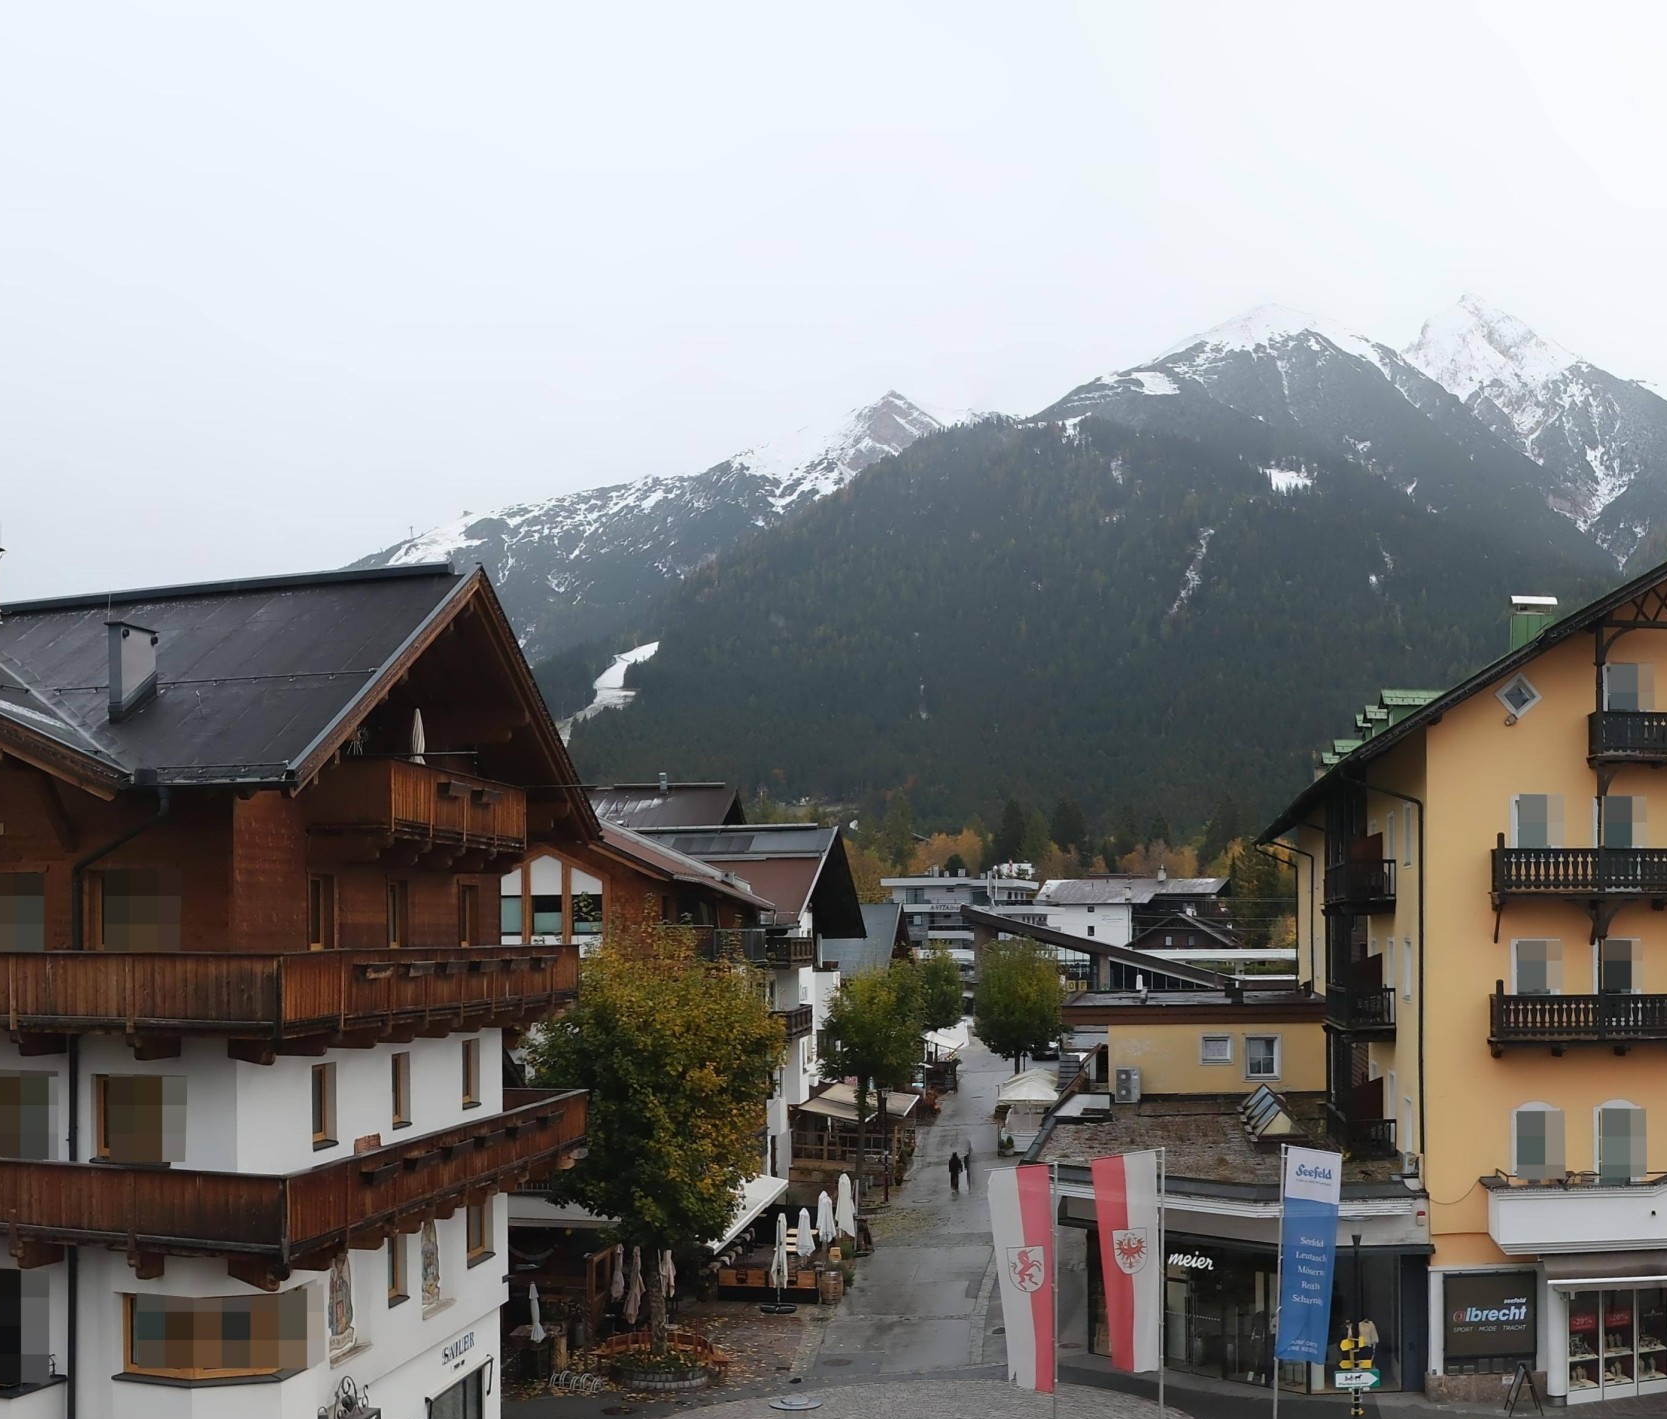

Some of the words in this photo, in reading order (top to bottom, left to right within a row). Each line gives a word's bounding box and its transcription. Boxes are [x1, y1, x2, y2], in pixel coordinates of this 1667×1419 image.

[1295, 1163, 1332, 1181] Seefeld
[1300, 1236, 1324, 1248] Seefeld
[1168, 1251, 1214, 1270] meier
[1295, 1251, 1327, 1263] Leutasch
[1297, 1265, 1325, 1276] Mösern
[1301, 1281, 1320, 1290] Reith
[1453, 1305, 1527, 1322] albrecht
[442, 1331, 475, 1366] SAILER
